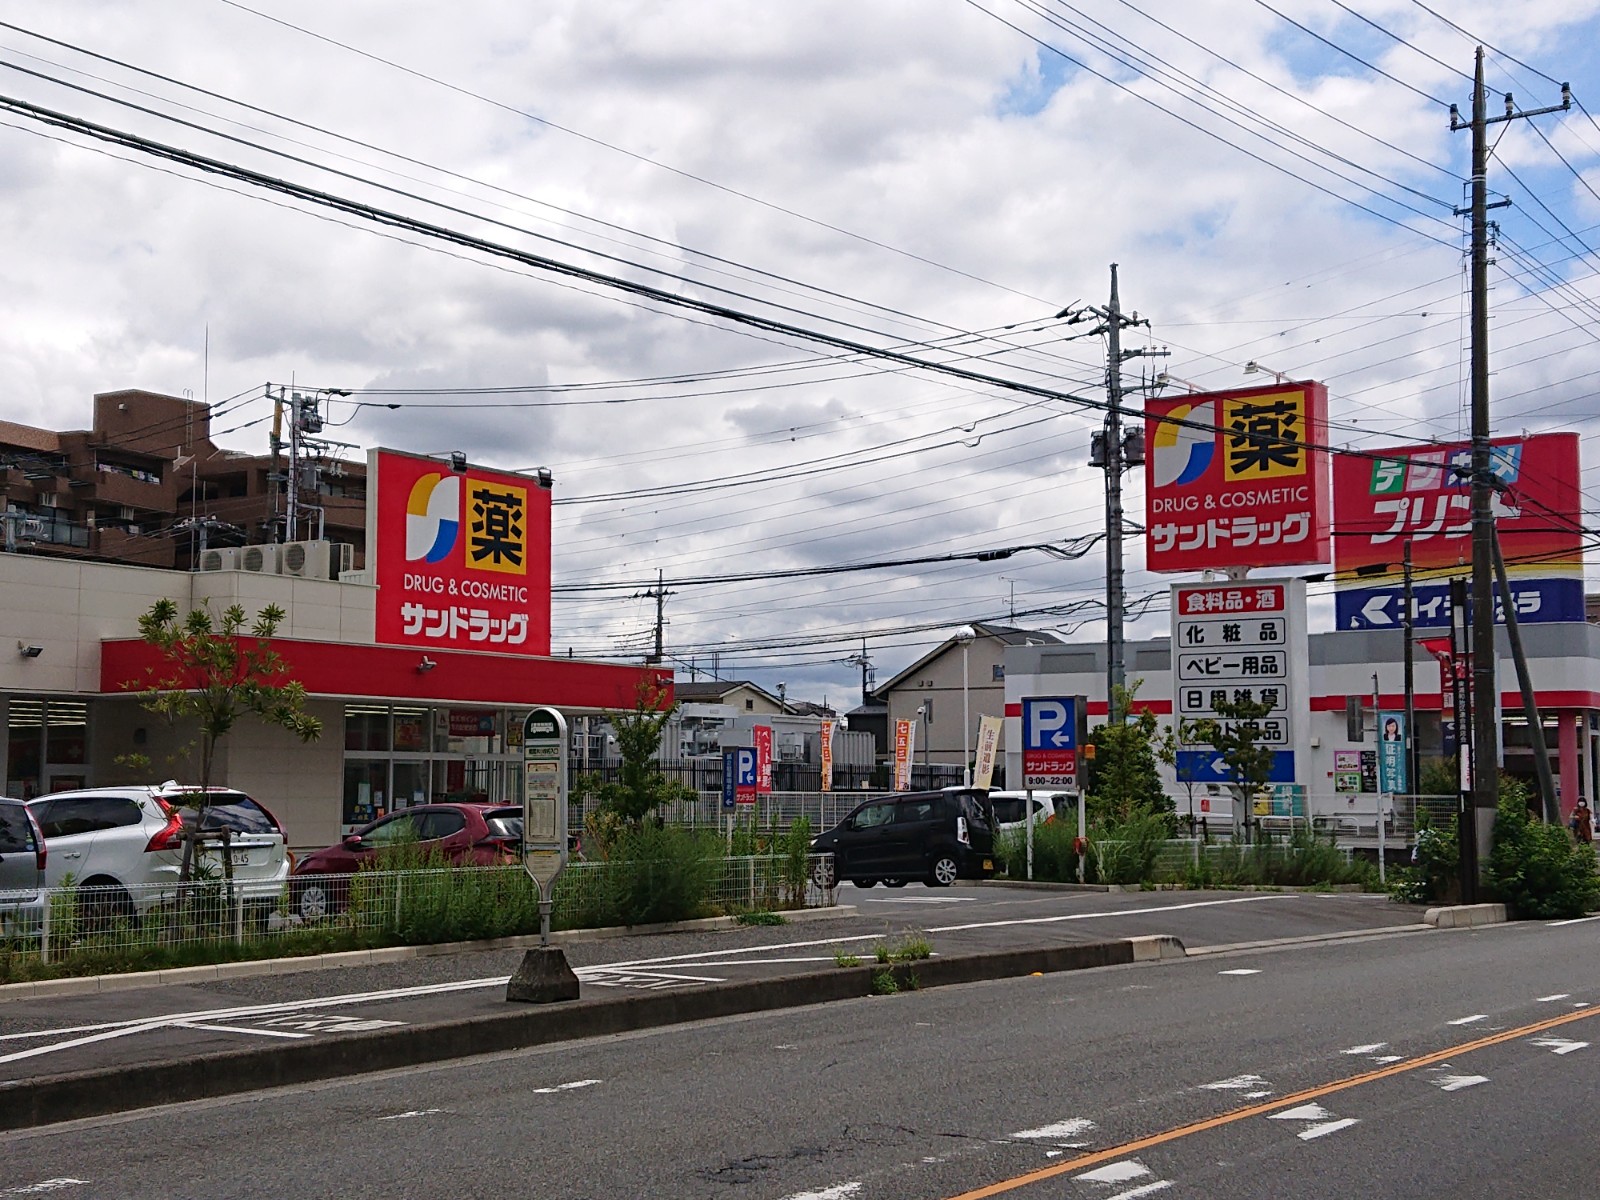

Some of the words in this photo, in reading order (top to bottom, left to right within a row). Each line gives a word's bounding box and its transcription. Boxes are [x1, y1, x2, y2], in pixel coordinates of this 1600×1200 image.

[1230, 400, 1299, 475] 薬
[1153, 495, 1199, 513] DRUG
[1204, 494, 1216, 509] &
[1219, 486, 1309, 508] COSMETIC
[471, 489, 523, 567] 薬
[1151, 511, 1311, 552] サンドラッグ
[404, 573, 444, 594] DRUG
[448, 578, 459, 595] &
[461, 580, 528, 603] COSMETIC
[1186, 589, 1276, 612] 食料品・酒
[401, 602, 530, 645] サンドラッグ
[1186, 622, 1278, 644] 化粧品
[1186, 655, 1278, 675] ベビー用品
[1030, 701, 1067, 747] P
[897, 723, 908, 759] 七五三
[738, 750, 753, 783] P
[1026, 761, 1074, 771] サンドラッグ
[1028, 776, 1073, 785] 9:00~22:00
